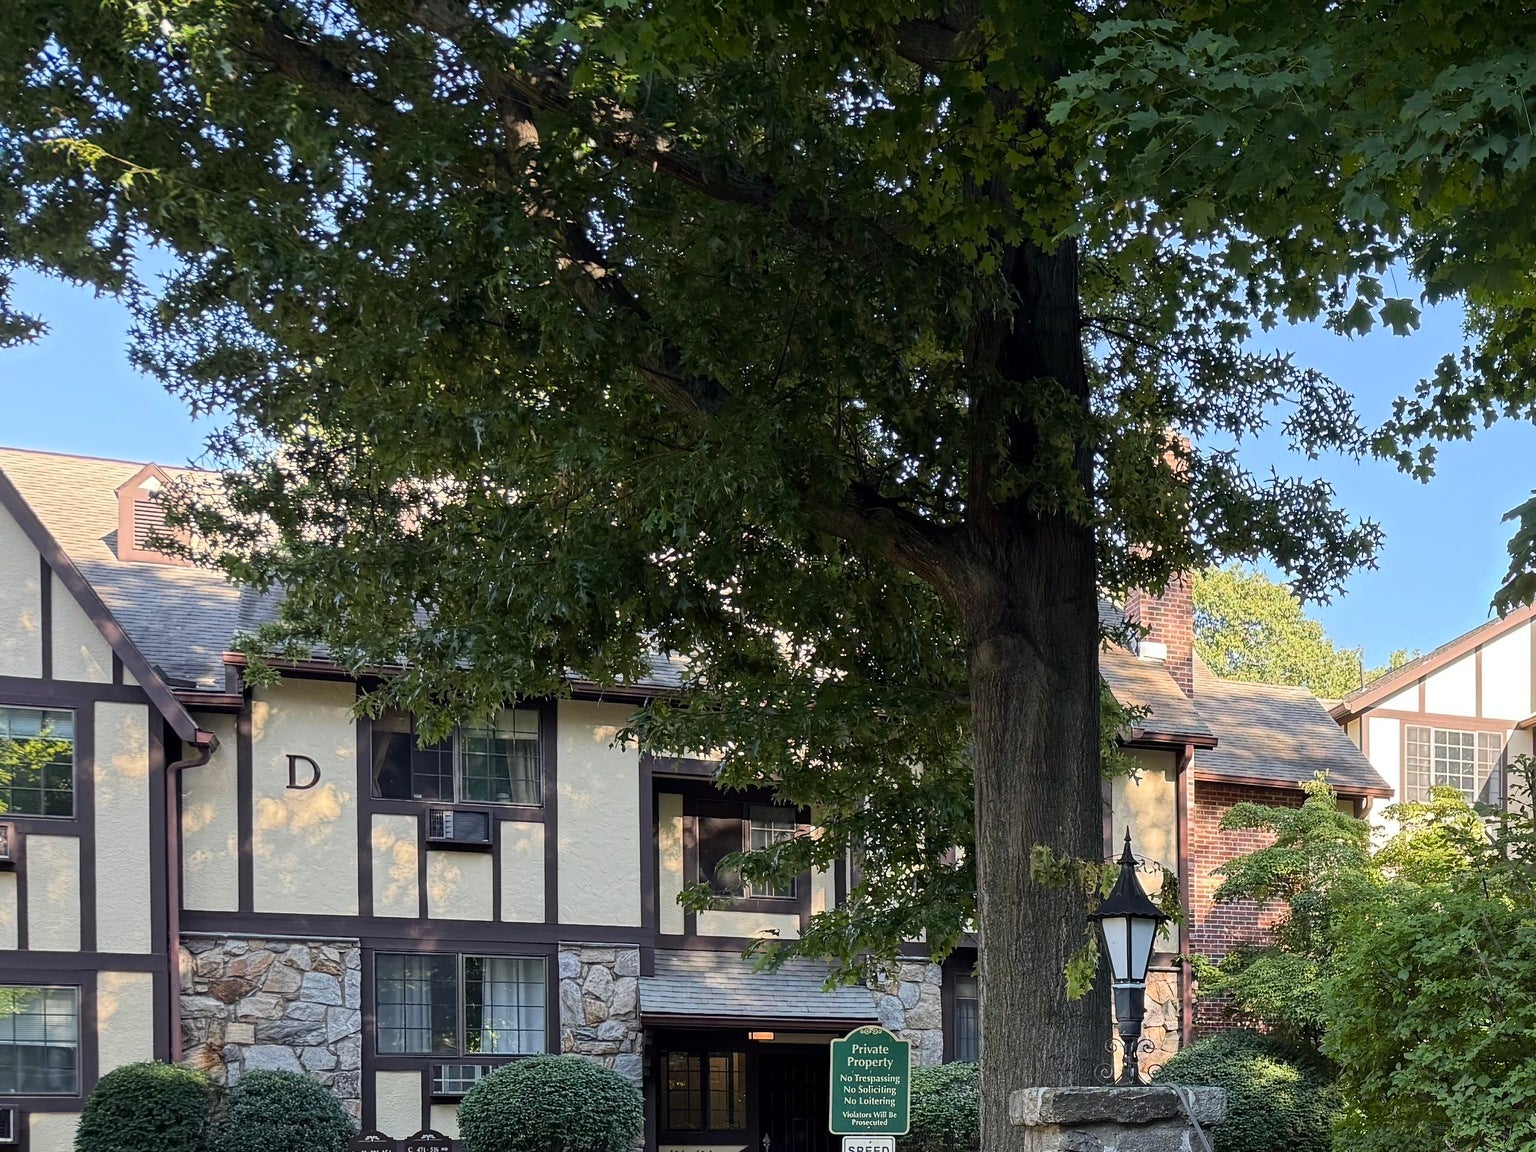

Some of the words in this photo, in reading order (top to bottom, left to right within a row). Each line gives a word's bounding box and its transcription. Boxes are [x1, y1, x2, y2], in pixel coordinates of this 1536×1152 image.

[285, 754, 321, 790] D
[852, 1043, 889, 1054] Private
[847, 1056, 893, 1070] Property
[840, 1074, 852, 1082] No
[854, 1074, 900, 1084] Trespassing
[843, 1085, 856, 1093] No
[858, 1085, 896, 1095] Soliciting
[844, 1097, 857, 1105] No
[859, 1097, 896, 1107] Loitering
